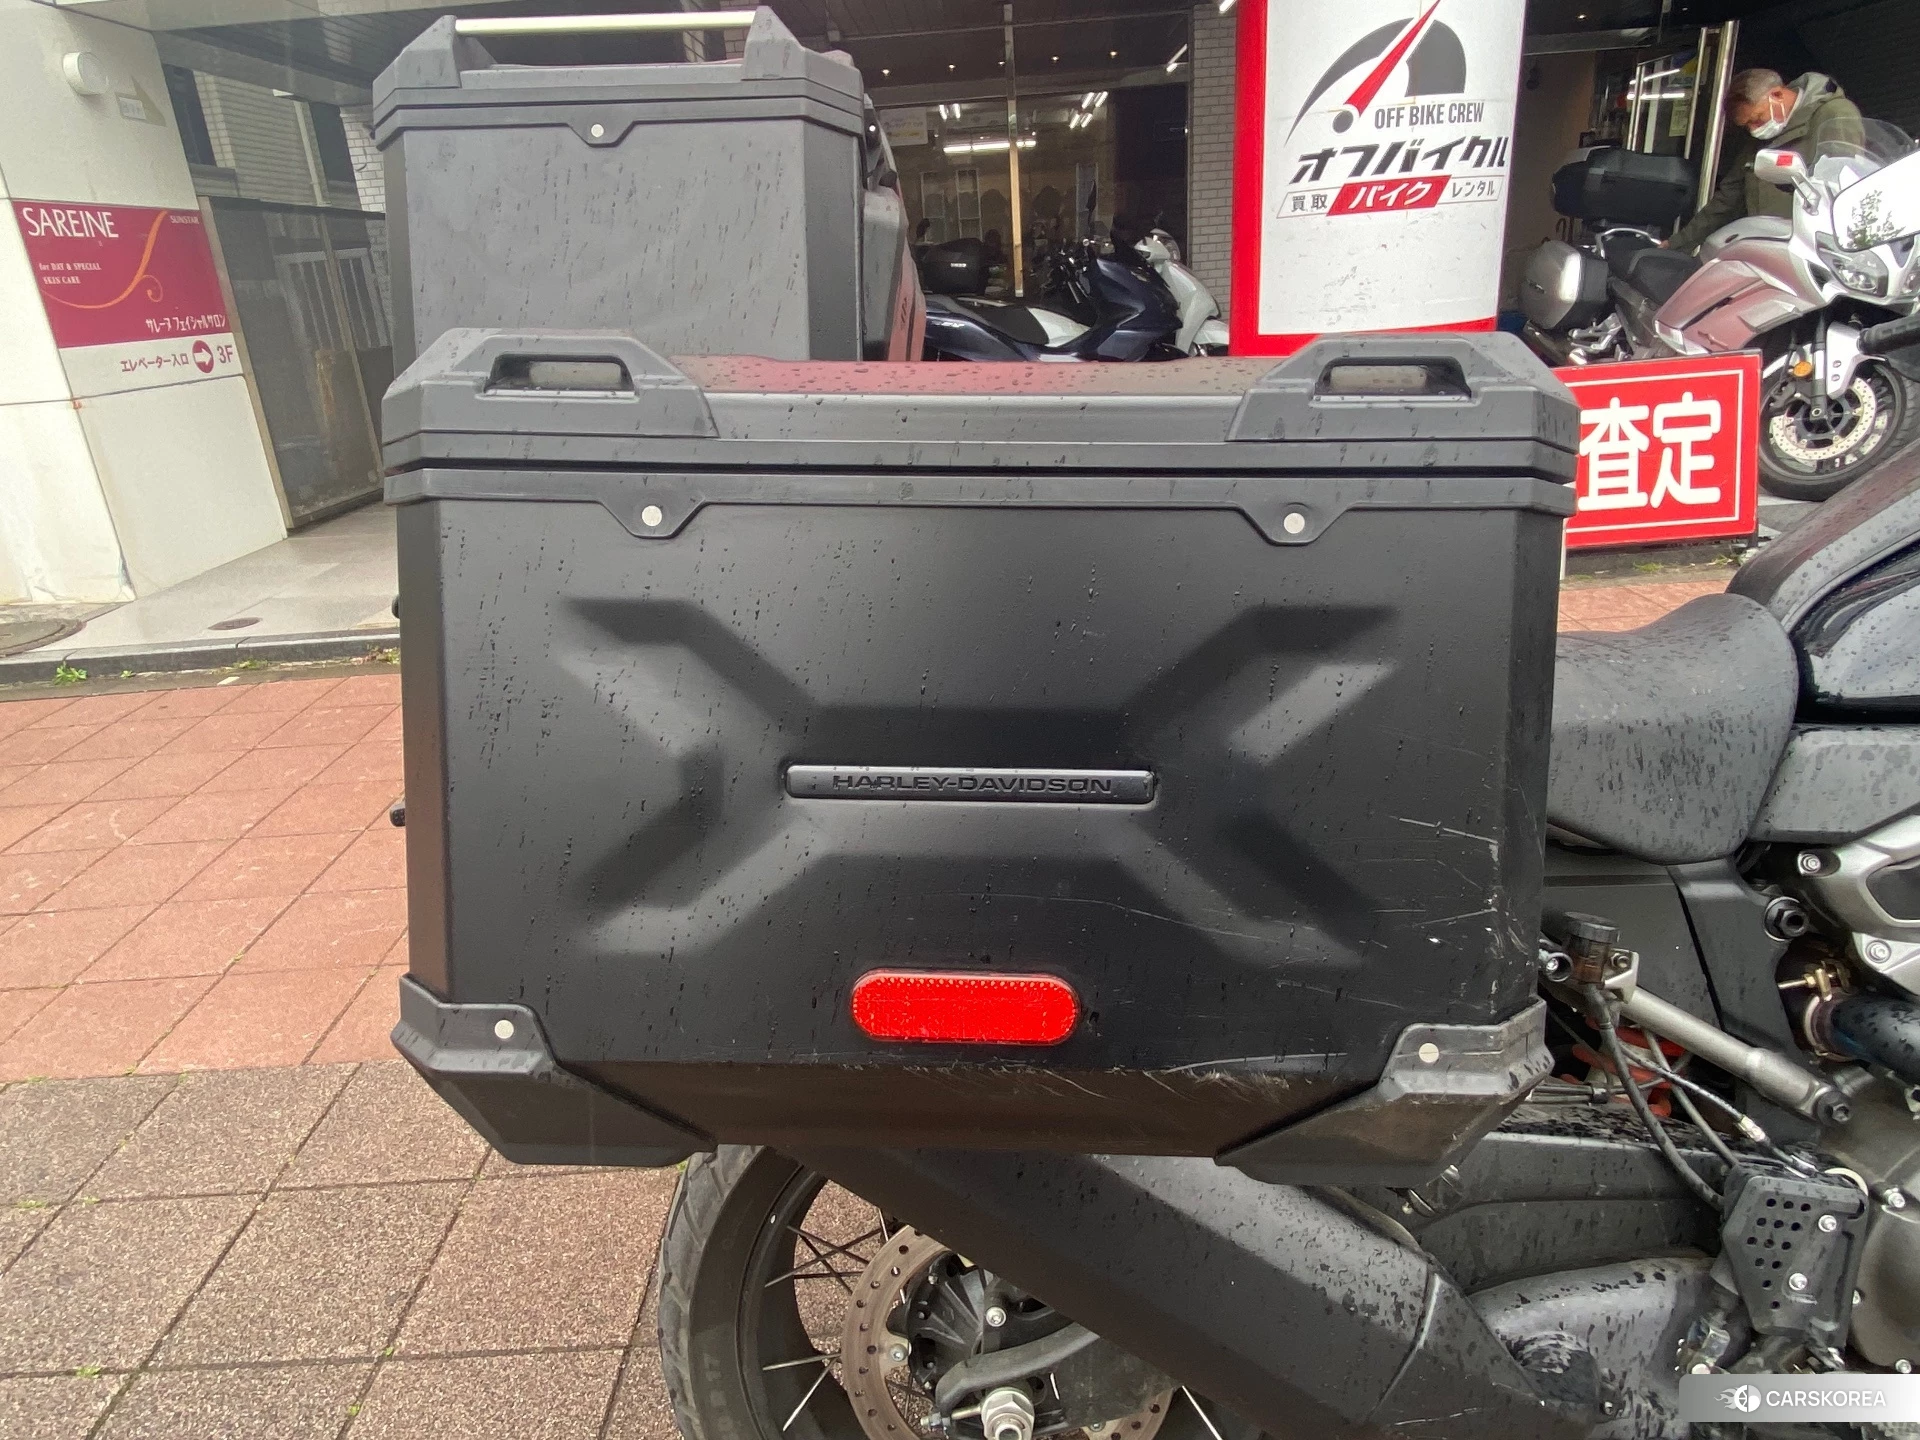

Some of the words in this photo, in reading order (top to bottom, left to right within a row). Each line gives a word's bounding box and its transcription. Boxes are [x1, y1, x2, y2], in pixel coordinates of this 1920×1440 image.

[1374, 107, 1405, 130] OFF
[1409, 103, 1446, 127] BIKE
[1448, 102, 1485, 124] CREW
[1289, 135, 1510, 185] オフバイクル
[1291, 193, 1328, 213] 買取
[1348, 181, 1433, 210] バイク
[1452, 180, 1495, 198] レンタル
[22, 207, 119, 238] SAREINE
[169, 215, 200, 225] SUNSTAR
[73, 262, 102, 271] SPECIAL
[43, 276, 61, 285] SKIN
[62, 275, 81, 284] CARE
[120, 352, 189, 373] エレベーター入口
[216, 344, 233, 364] 3F
[1578, 391, 1722, 511] 査定
[832, 774, 1113, 795] HARLEY-DAVIDSON
